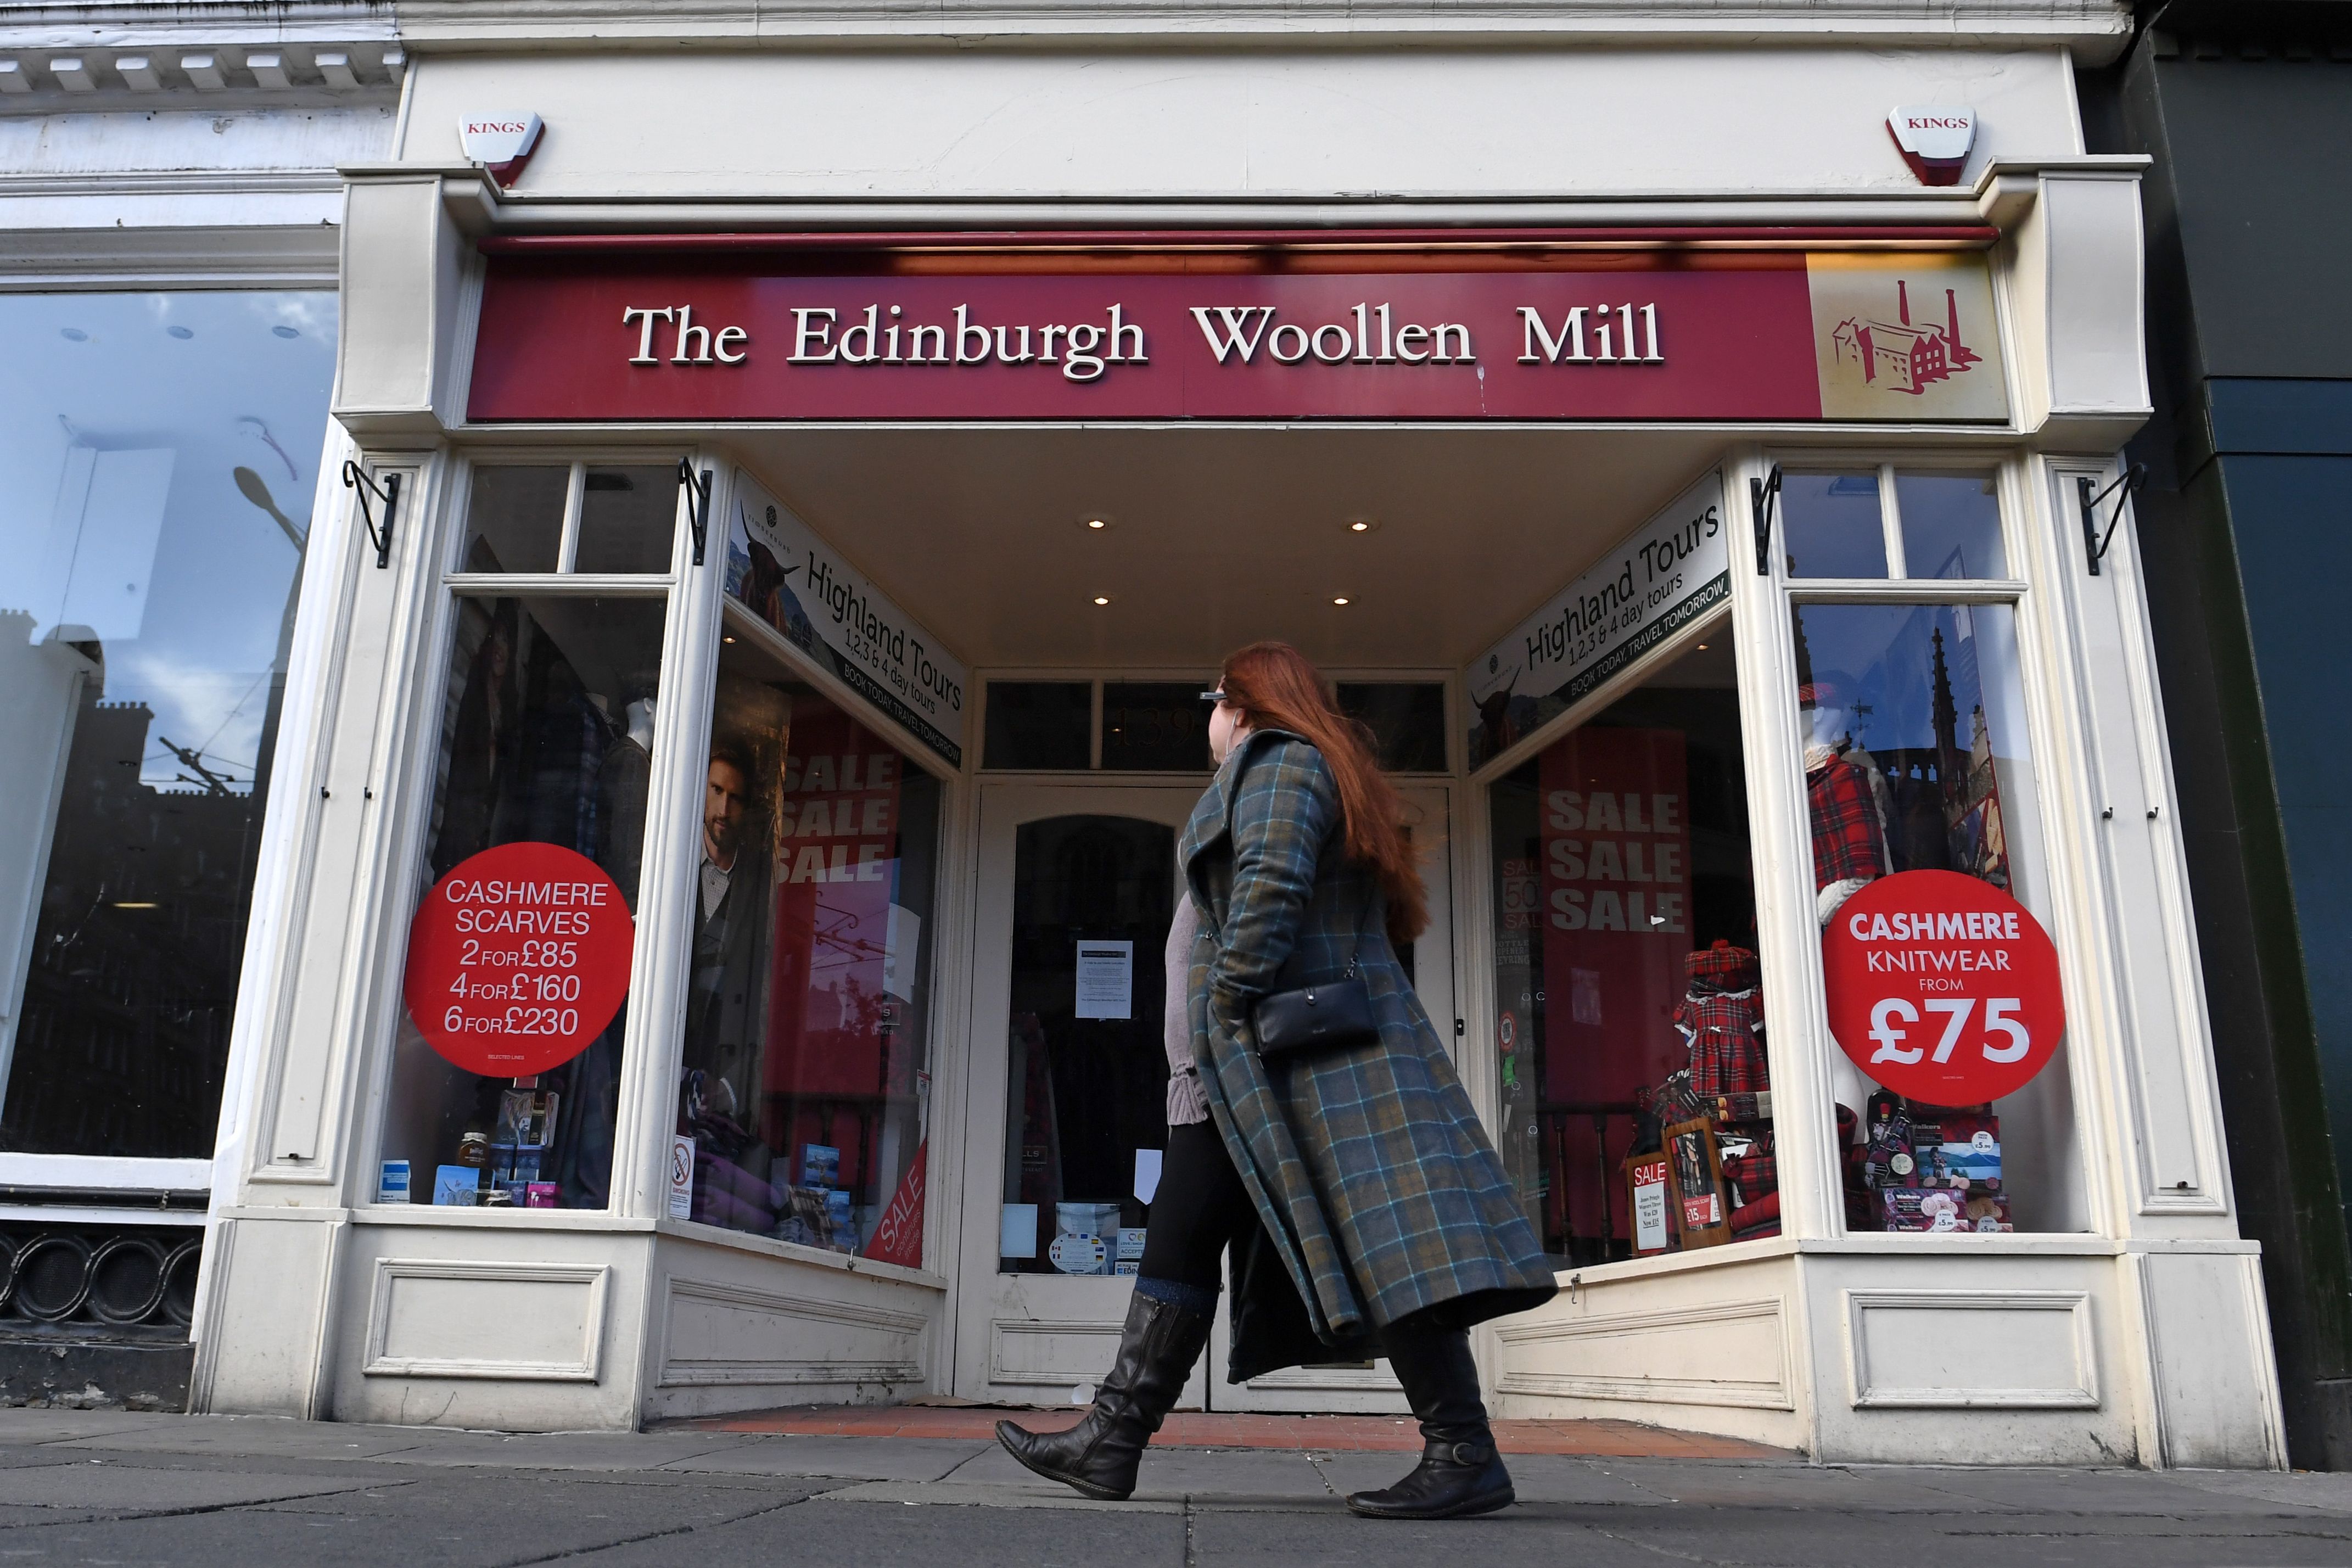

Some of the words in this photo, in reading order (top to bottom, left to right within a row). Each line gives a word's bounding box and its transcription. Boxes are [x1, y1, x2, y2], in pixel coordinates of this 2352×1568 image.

[467, 122, 525, 135] KINGS
[1907, 117, 1969, 129] KINGS
[623, 304, 749, 365] The
[786, 303, 1149, 382] Edinburgh
[1189, 302, 1476, 366] Woollen
[1516, 302, 1665, 365] Mill
[1526, 559, 1635, 671] Highland
[1639, 505, 1718, 583] Tours
[807, 550, 905, 666] Highland
[911, 639, 961, 712] Tours
[1569, 631, 1595, 667] 1,2,3
[1599, 625, 1606, 645] &
[1610, 615, 1619, 635] 4
[1621, 600, 1645, 628] day
[1648, 573, 1683, 609] tours
[845, 629, 869, 661] 1,2,3
[872, 649, 880, 668] &
[882, 658, 889, 676] 4
[891, 665, 909, 698] day
[911, 677, 936, 714] tours
[1572, 673, 1595, 696] BOOK
[1597, 648, 1627, 675] TODAY,
[1628, 624, 1663, 656] TRAVEL
[844, 664, 867, 692] BOOK
[868, 682, 894, 713] TODAY,
[894, 701, 920, 731] TRAVEL
[921, 720, 960, 762] TOMORROW
[1548, 790, 1681, 833] SALE
[1504, 860, 1539, 877] SAL
[1549, 839, 1683, 883] SALE
[445, 880, 609, 906] CASHMERE
[455, 909, 590, 935] SCARVES
[1505, 913, 1542, 929] SAL
[1550, 888, 1685, 933] SALE
[1849, 912, 2020, 941] CASHMERE
[460, 939, 479, 966] 2
[481, 950, 519, 967] FOR
[521, 940, 578, 968] £85
[1496, 956, 1530, 966] EYRING
[1867, 950, 2011, 972] KNITWEAR
[449, 972, 468, 999] 4
[470, 984, 508, 1000] FOR
[510, 973, 580, 1002] £160
[1919, 978, 1964, 991] FROM
[444, 1005, 462, 1032] 6
[464, 1017, 502, 1033] FOR
[503, 1006, 578, 1035] £230
[1868, 998, 2030, 1065] £75
[1634, 1162, 1666, 1186] SALE
[881, 1164, 922, 1252] SALE
[1687, 1207, 1699, 1222] £15
[897, 1209, 921, 1257] continues
